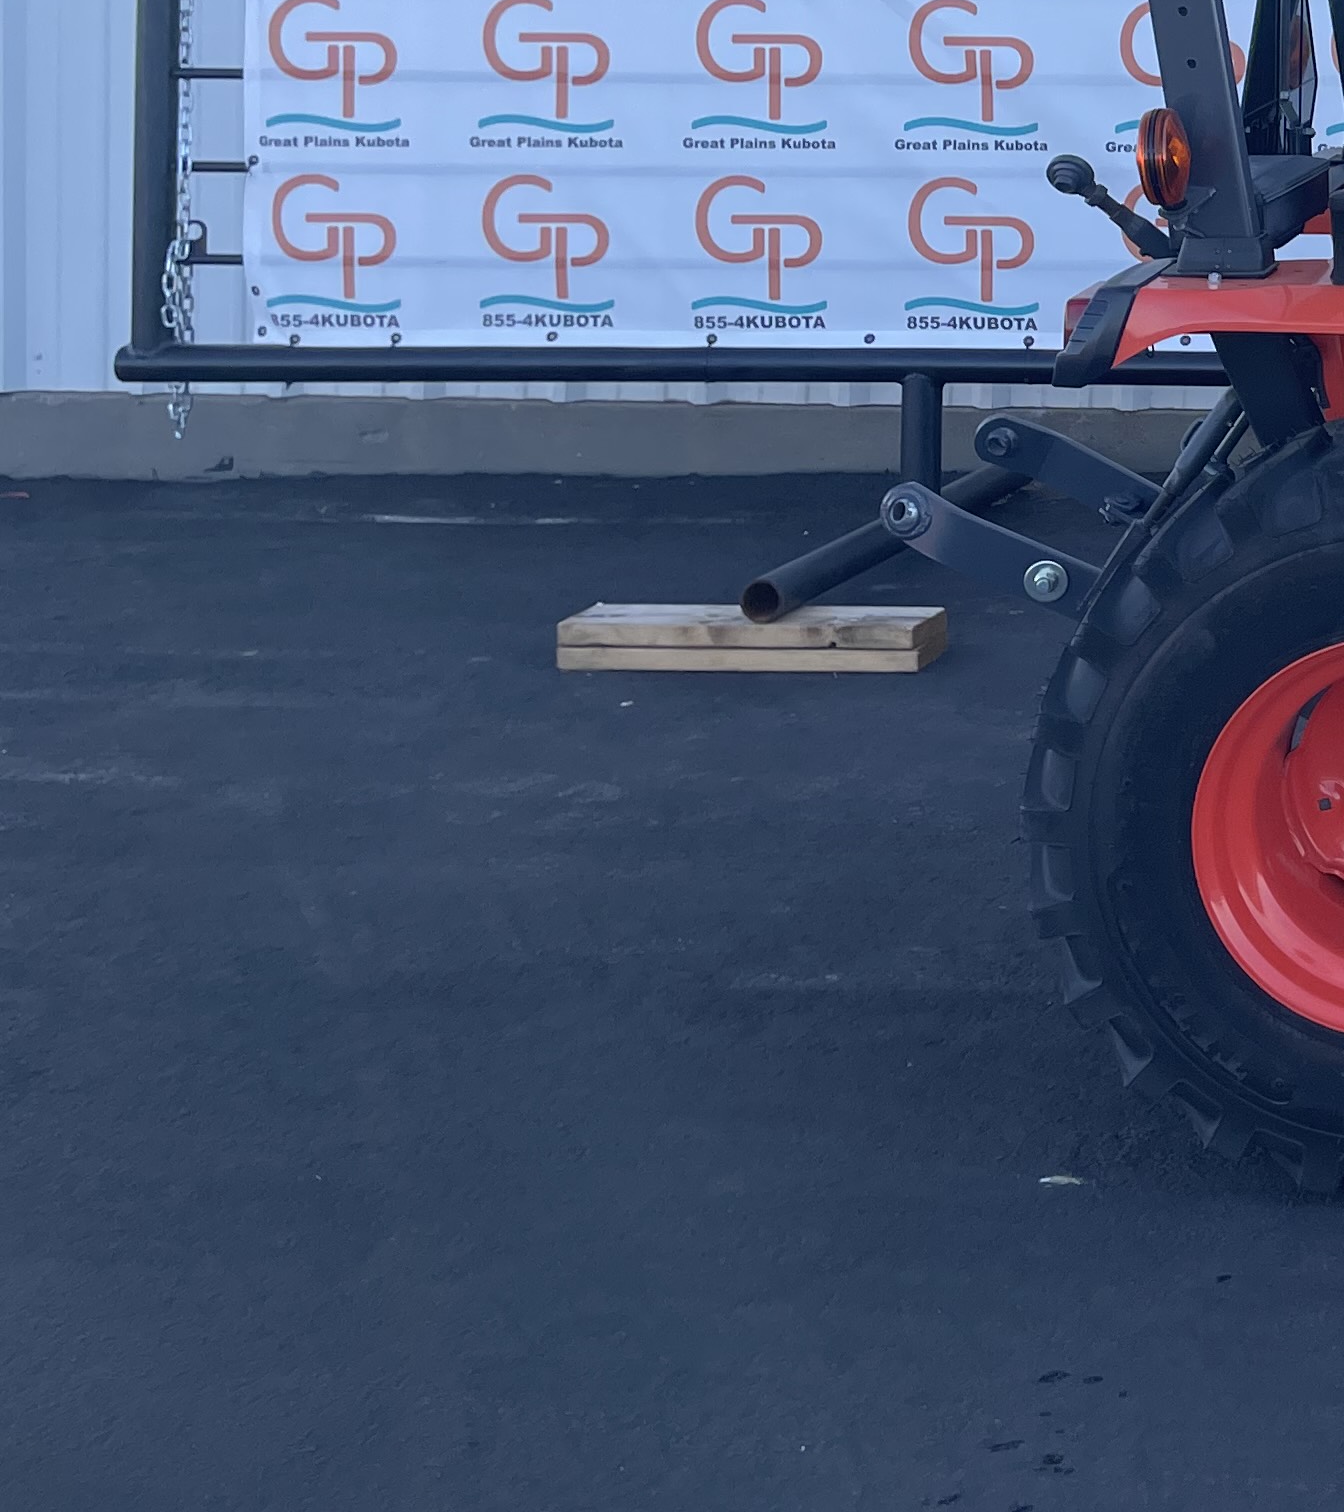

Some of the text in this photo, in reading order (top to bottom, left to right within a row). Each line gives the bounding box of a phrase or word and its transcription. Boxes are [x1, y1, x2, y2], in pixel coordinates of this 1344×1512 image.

[259, 136, 409, 147] Great Plains Kubota
[470, 136, 623, 148] Great Plains Kubota
[683, 138, 835, 149] Great Plains Kubota
[895, 139, 1047, 151] Great Plains Kubota
[272, 174, 397, 299] GP
[482, 175, 608, 299] GP
[696, 176, 822, 300] GP
[908, 177, 1034, 302] GP
[483, 314, 613, 327] 855-4KUBOTA
[694, 316, 825, 329] 855-4KUBOTA
[907, 316, 1037, 331] 855-4KUBOTA
